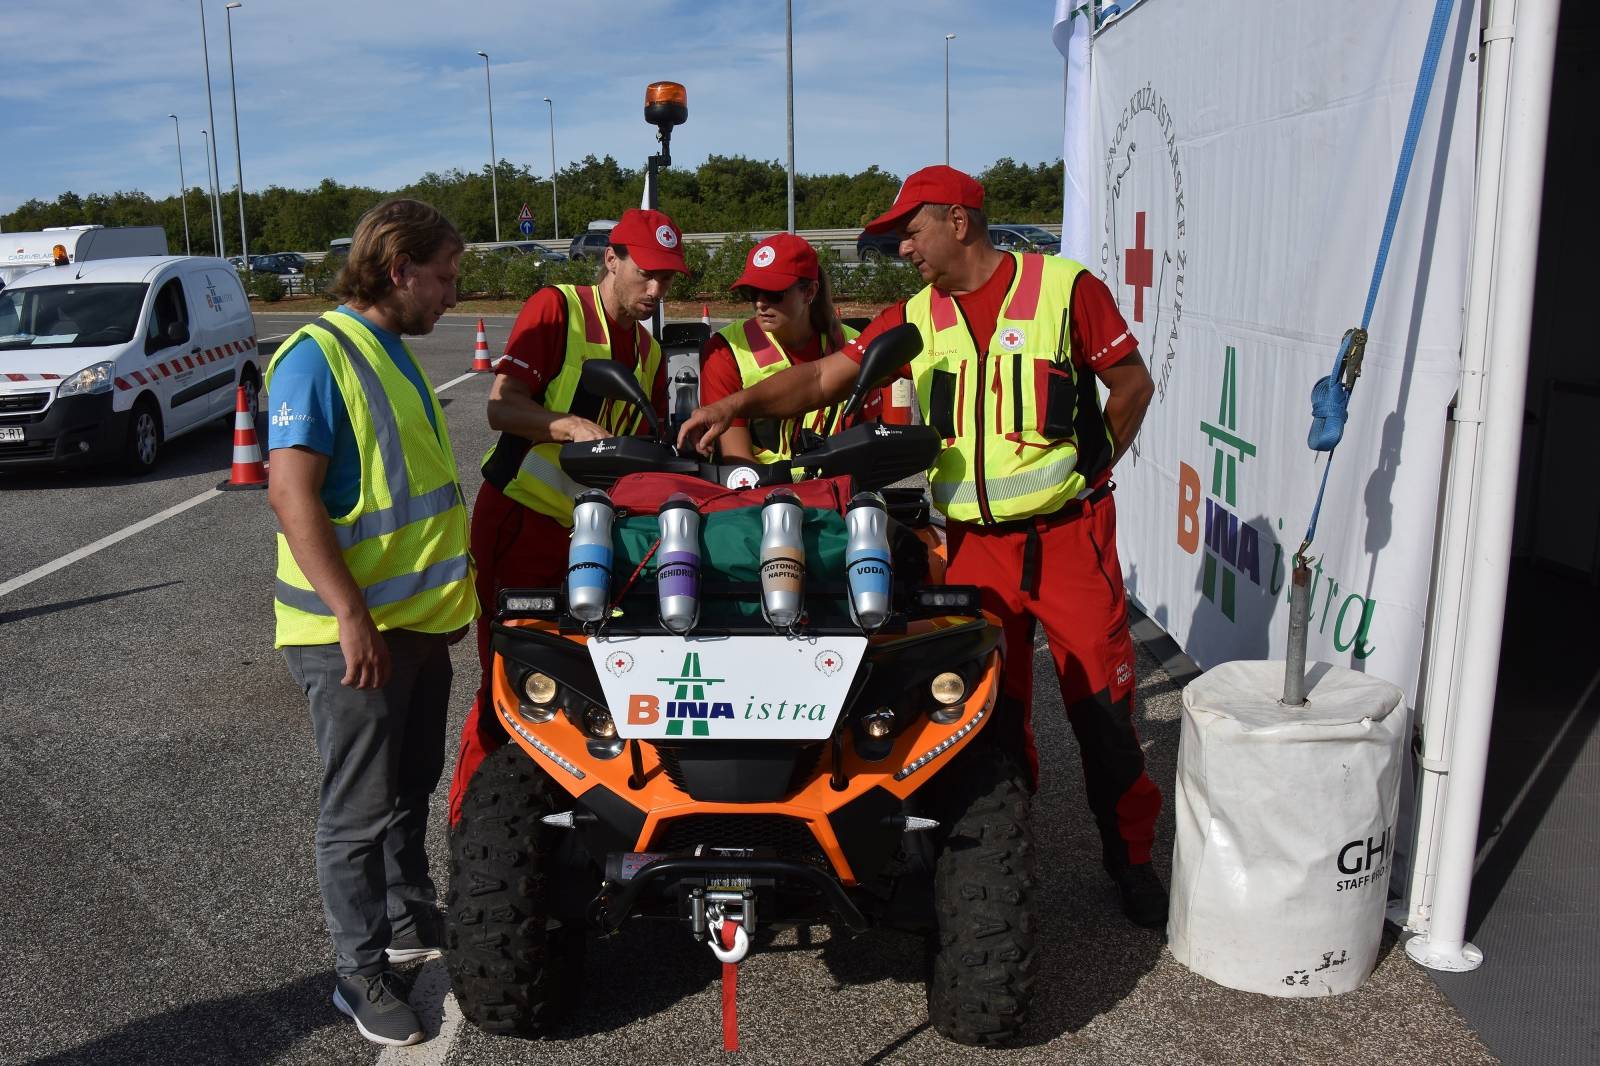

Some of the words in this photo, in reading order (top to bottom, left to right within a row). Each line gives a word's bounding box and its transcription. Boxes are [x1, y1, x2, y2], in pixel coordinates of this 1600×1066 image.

[1130, 80, 1157, 120] KRIŽA
[1158, 96, 1186, 240] ISTARSKE
[1177, 460, 1261, 586] BINA
[857, 566, 884, 575] VODA
[627, 694, 735, 725] BINA
[744, 696, 826, 722] istra
[1336, 875, 1370, 892] STAFF
